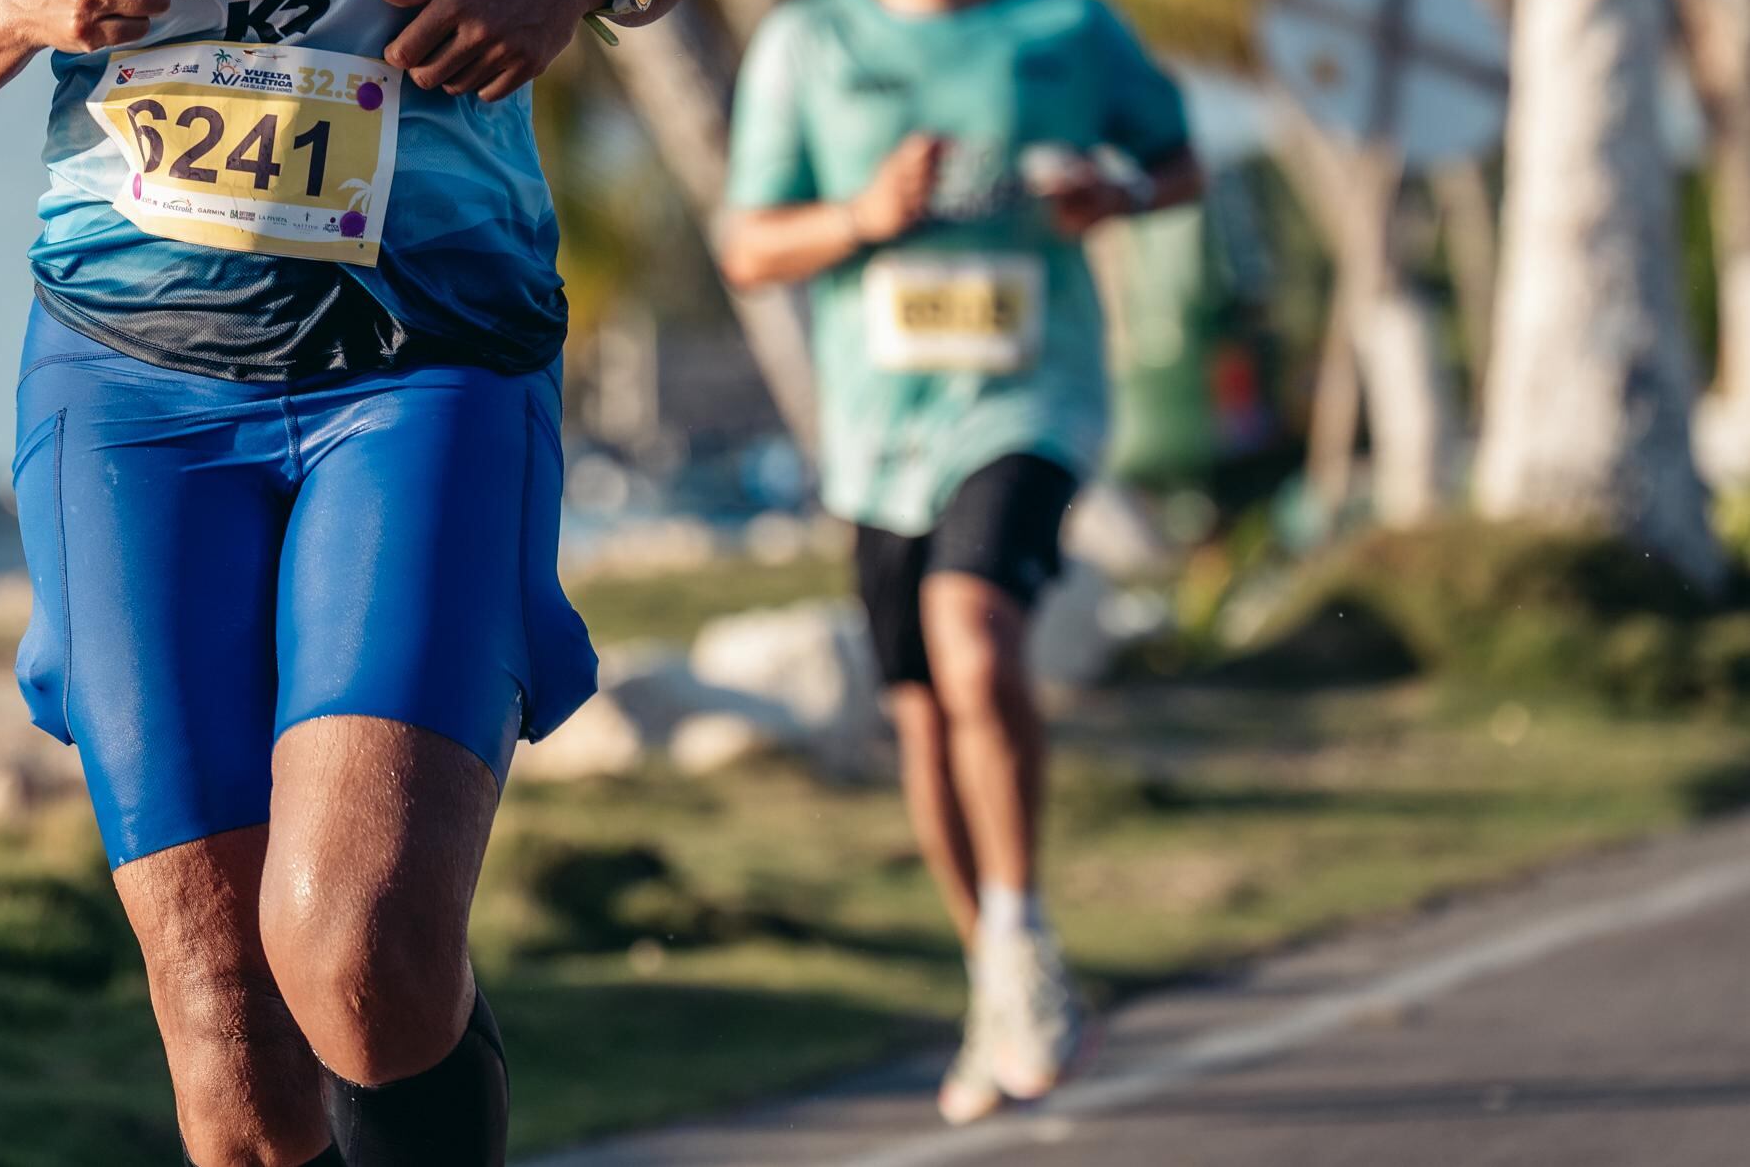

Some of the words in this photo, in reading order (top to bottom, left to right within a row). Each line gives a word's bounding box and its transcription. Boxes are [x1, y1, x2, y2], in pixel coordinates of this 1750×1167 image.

[244, 68, 291, 81] VUELTA
[126, 98, 331, 197] 6241
[197, 207, 226, 217] GARMIN
